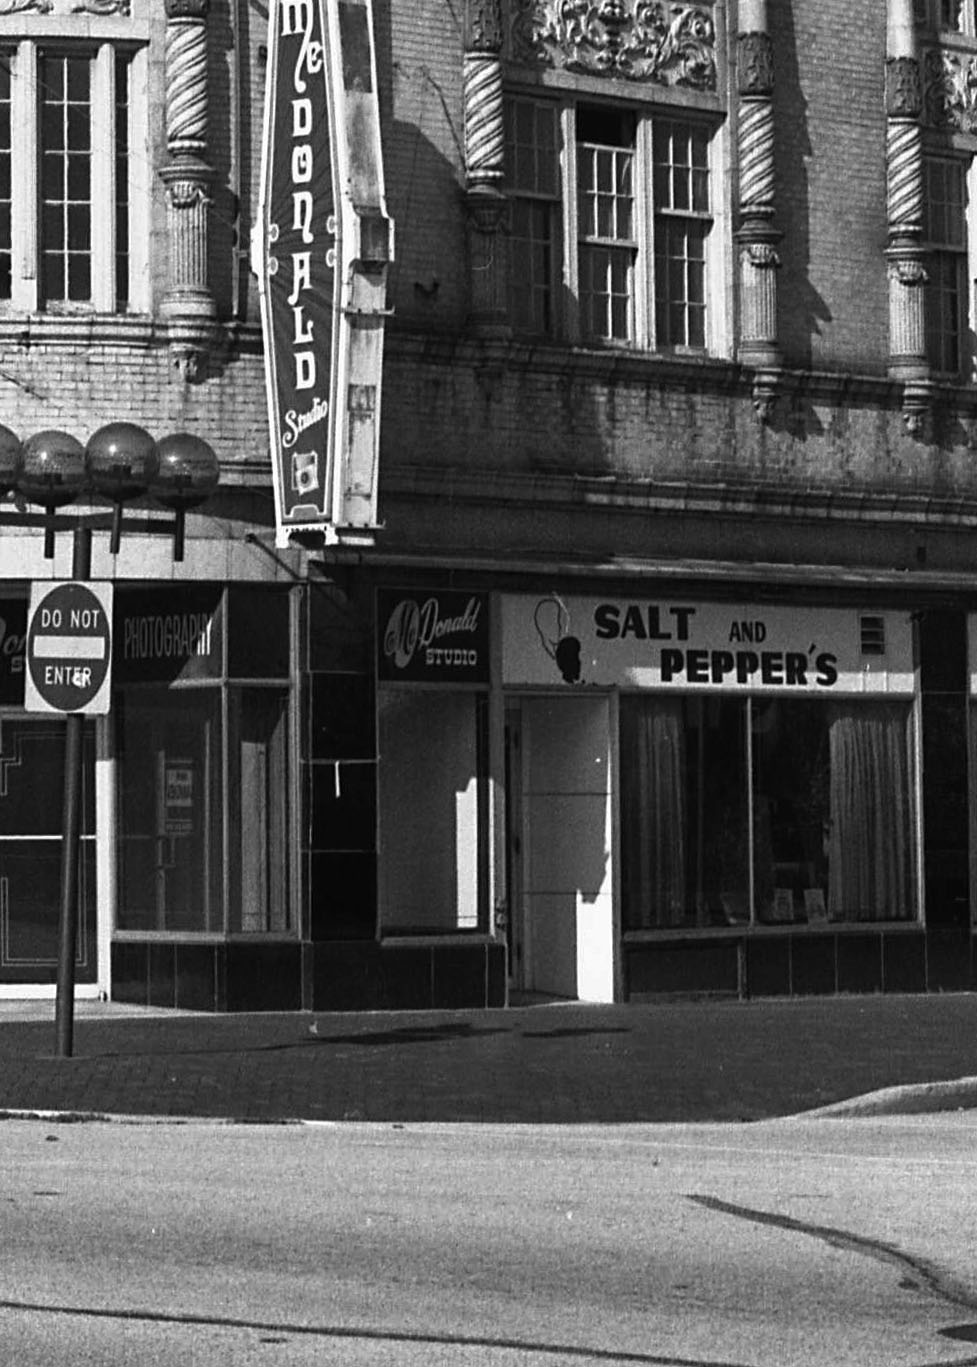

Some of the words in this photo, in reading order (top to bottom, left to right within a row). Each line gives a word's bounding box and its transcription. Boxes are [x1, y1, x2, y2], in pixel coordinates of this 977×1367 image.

[282, 397, 328, 448] Studio
[41, 609, 62, 628] DO
[70, 609, 100, 628] NOT
[123, 613, 215, 659] PHOTOGRAPHY
[593, 604, 696, 641] SALT
[729, 621, 767, 643] AND
[45, 665, 92, 686] ENTER
[426, 648, 477, 665] STUDIO
[660, 642, 839, 687] PEPPER'S
